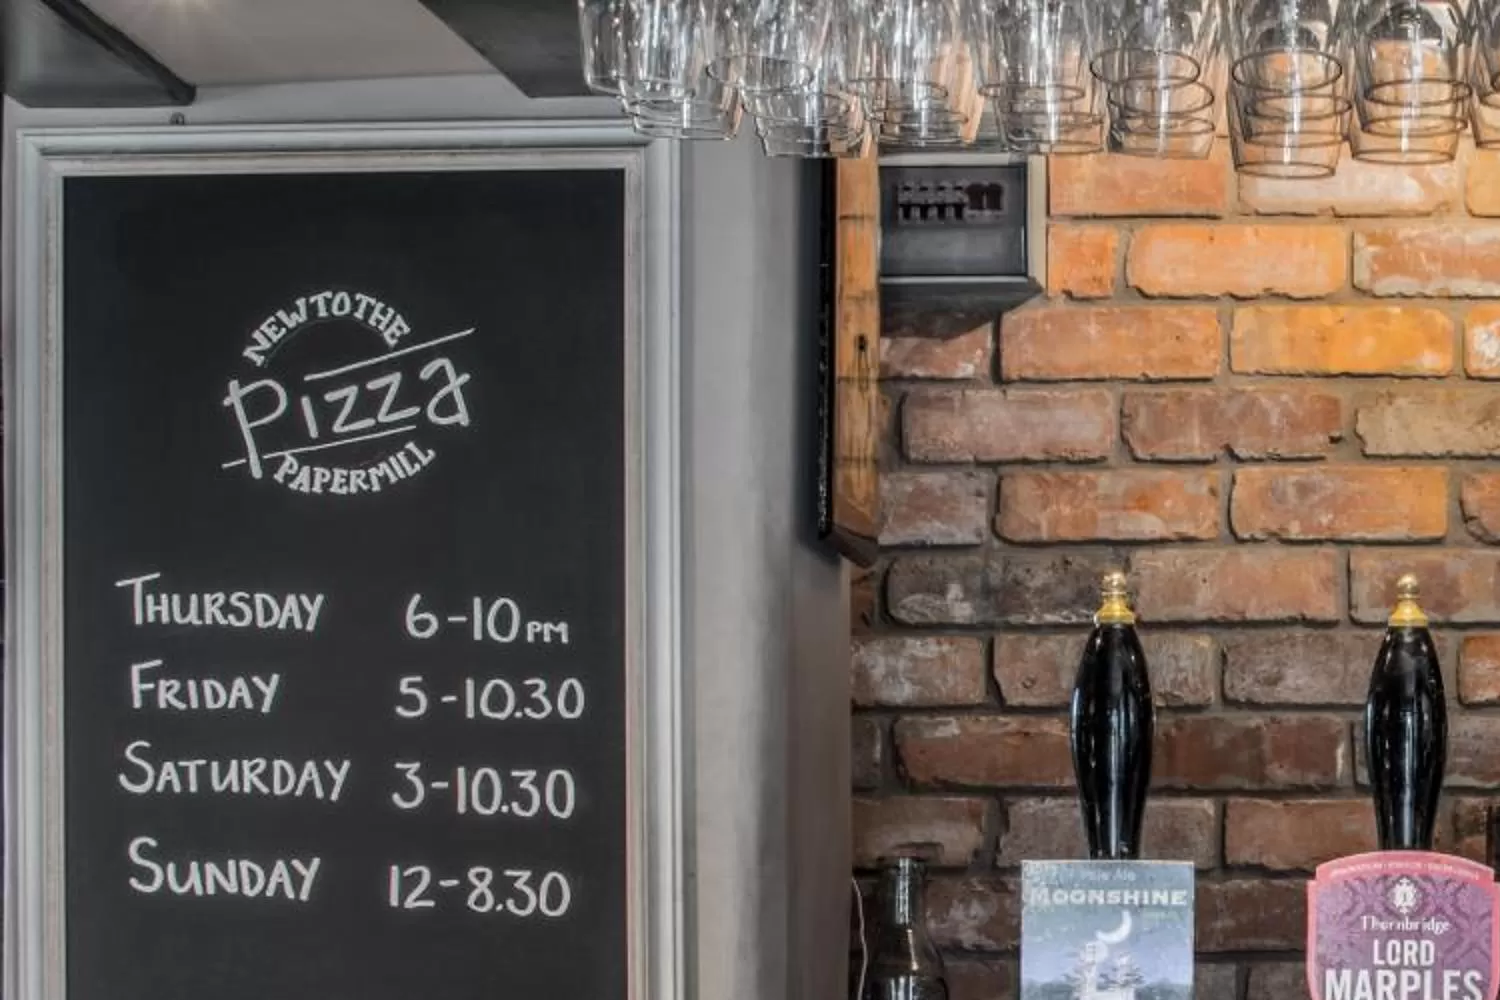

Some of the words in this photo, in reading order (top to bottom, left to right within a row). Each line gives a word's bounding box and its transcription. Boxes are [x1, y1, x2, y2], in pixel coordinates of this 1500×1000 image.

[242, 296, 308, 367] NEW
[309, 291, 352, 318] TO
[353, 292, 412, 348] THE
[272, 441, 437, 495] PAPERMILL
[115, 572, 324, 632] THURSDAY
[129, 658, 280, 714] FRIDAY
[118, 740, 351, 802] SATURDAY
[128, 836, 321, 901] SUNDAY
[1030, 887, 1189, 906] MOONSHINE
[1360, 915, 1452, 935] Thornbridge
[1372, 938, 1436, 967] LORD
